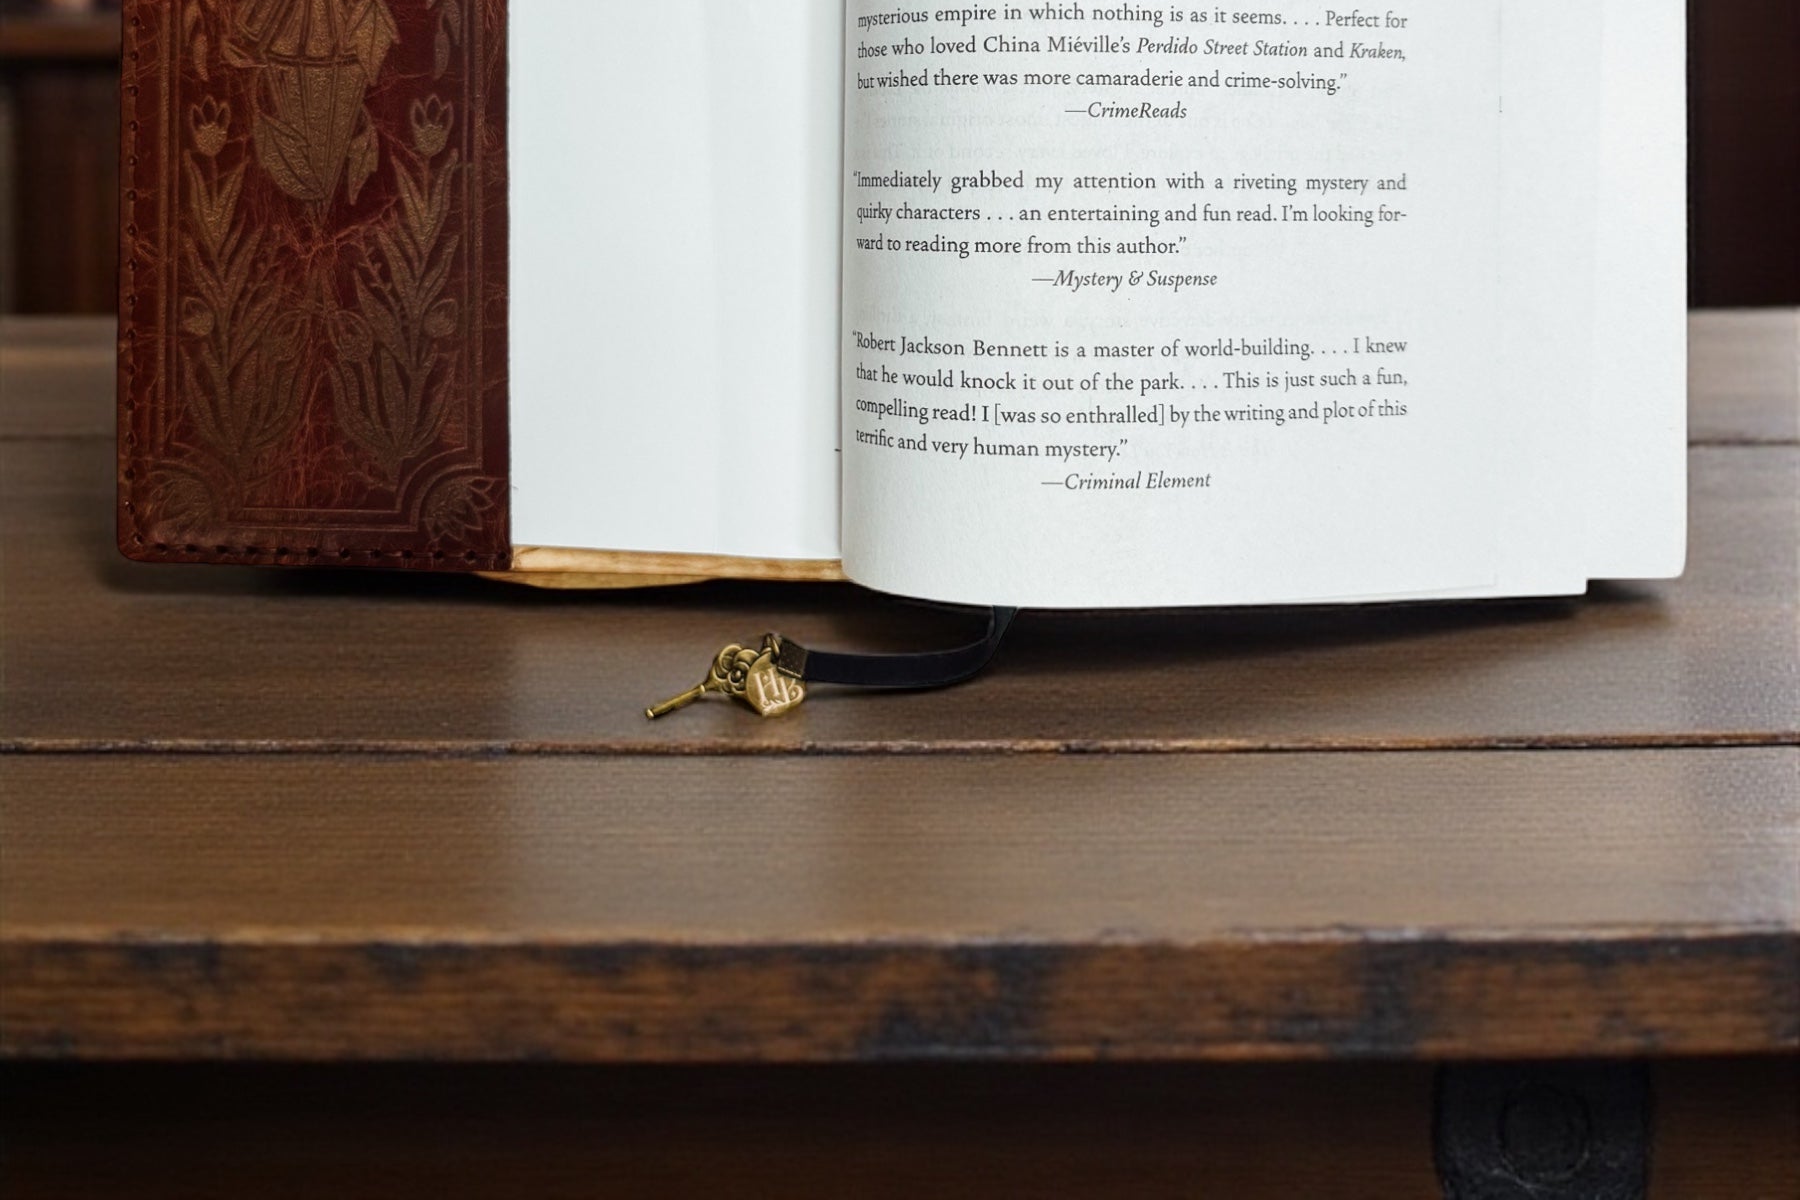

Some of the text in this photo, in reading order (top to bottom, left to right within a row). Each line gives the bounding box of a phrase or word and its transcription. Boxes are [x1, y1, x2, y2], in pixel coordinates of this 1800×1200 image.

[856, 33, 1407, 63] those who loved China Miéville’s Perdido Street Station and Kraken,
[856, 67, 1348, 96] but wished there was more camaraderie and crime-solving.”
[1064, 100, 1188, 119] —CrimeReads
[950, 169, 1025, 195] grabbed
[1034, 176, 1064, 195] my
[1072, 171, 1157, 190] attention
[1165, 170, 1206, 190] with
[1214, 177, 1225, 190] a
[1232, 172, 1298, 197] riveting
[1305, 177, 1370, 196] mystery
[1376, 172, 1408, 191] and
[855, 232, 1187, 260] ward to reading more from this author.”
[1031, 269, 1218, 294] —Mystery & Suspense
[855, 397, 1408, 429] compelling read! I [was so enthralled] by the writing and plot of this
[1040, 469, 1212, 491] —Criminal Element
